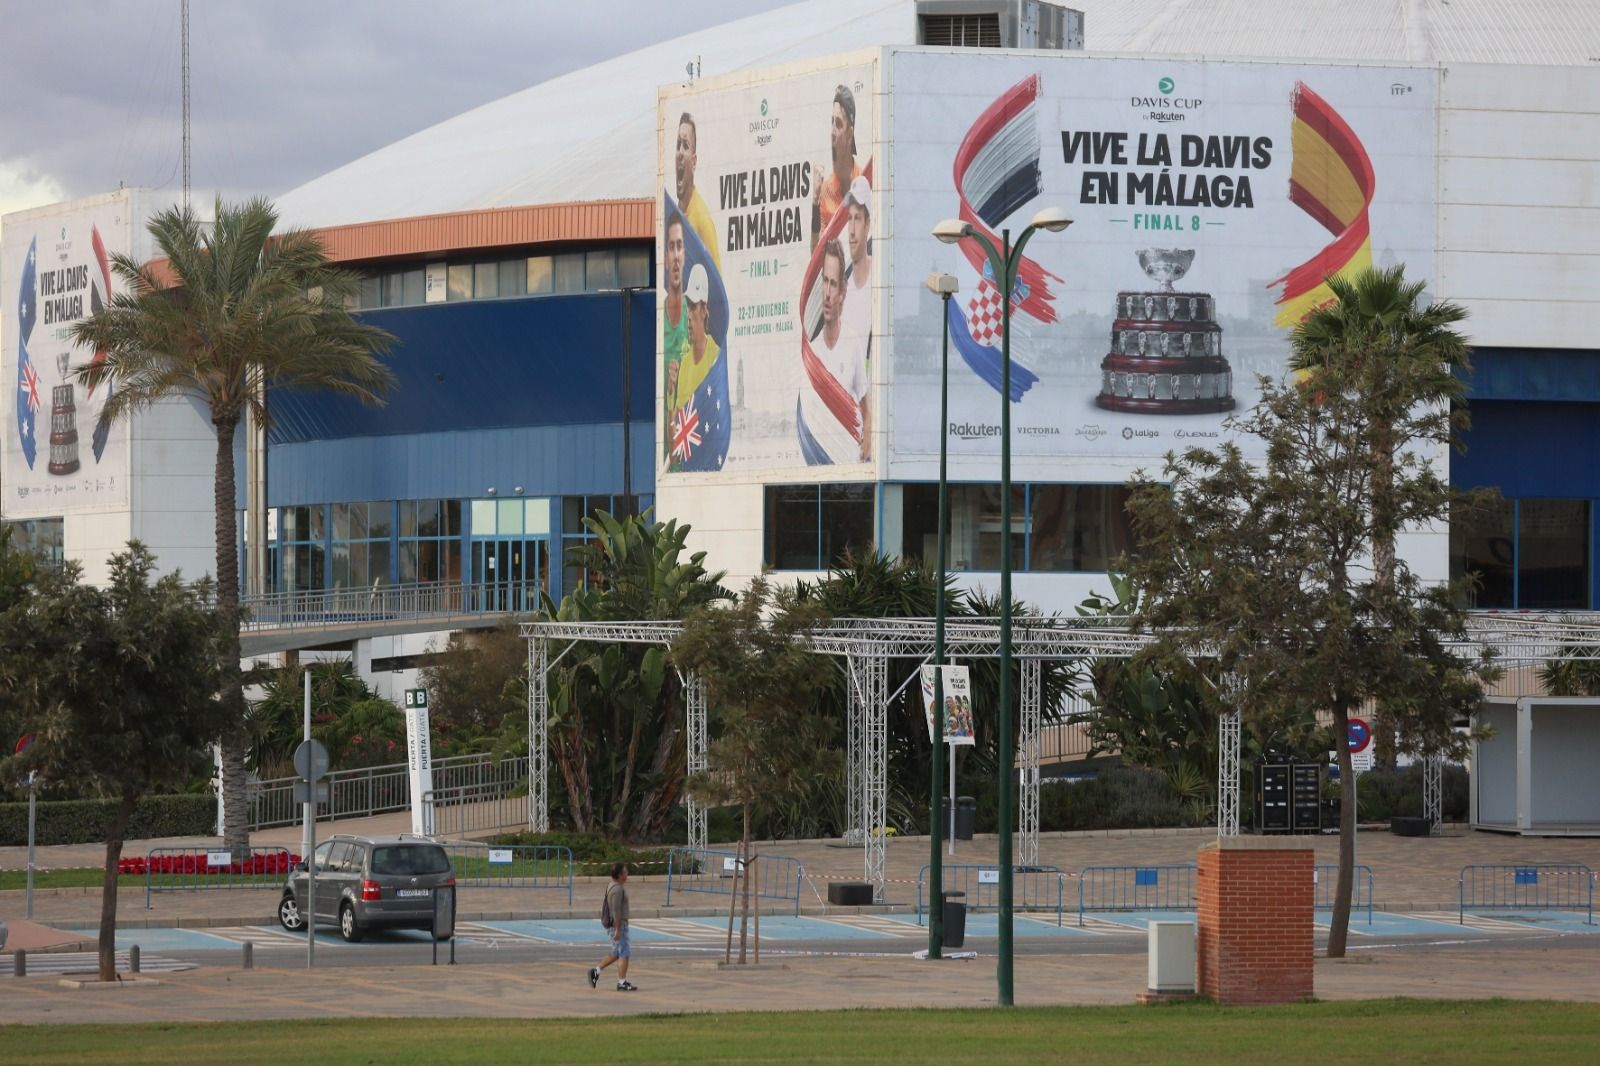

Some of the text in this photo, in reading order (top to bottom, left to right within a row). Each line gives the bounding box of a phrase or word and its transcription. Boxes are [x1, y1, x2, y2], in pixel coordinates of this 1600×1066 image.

[1131, 97, 1202, 109] DAVIS CUP
[749, 117, 780, 133] DAVIS CUP
[1150, 111, 1185, 123] Rakuten
[1061, 131, 1273, 169] VIVE LA DAVIS
[719, 161, 811, 210] VIVE LA DAVIS
[1080, 168, 1254, 209] EN MÁLAGA
[727, 206, 802, 252] EN MÁLAGA
[1133, 213, 1201, 231] FINAL 8
[750, 258, 778, 278] FINAL 8
[41, 264, 88, 296] VIVE LA DAVIS
[45, 295, 83, 324] EN MÁLAGA
[738, 301, 789, 321] 22-27 NOVIEMBRE
[752, 323, 772, 335] CARPENA
[949, 422, 1002, 440] Rakuten
[1017, 426, 1061, 435] VICTORIA
[1135, 428, 1160, 438] LaLiga
[407, 693, 414, 705] B
[417, 692, 425, 704] B
